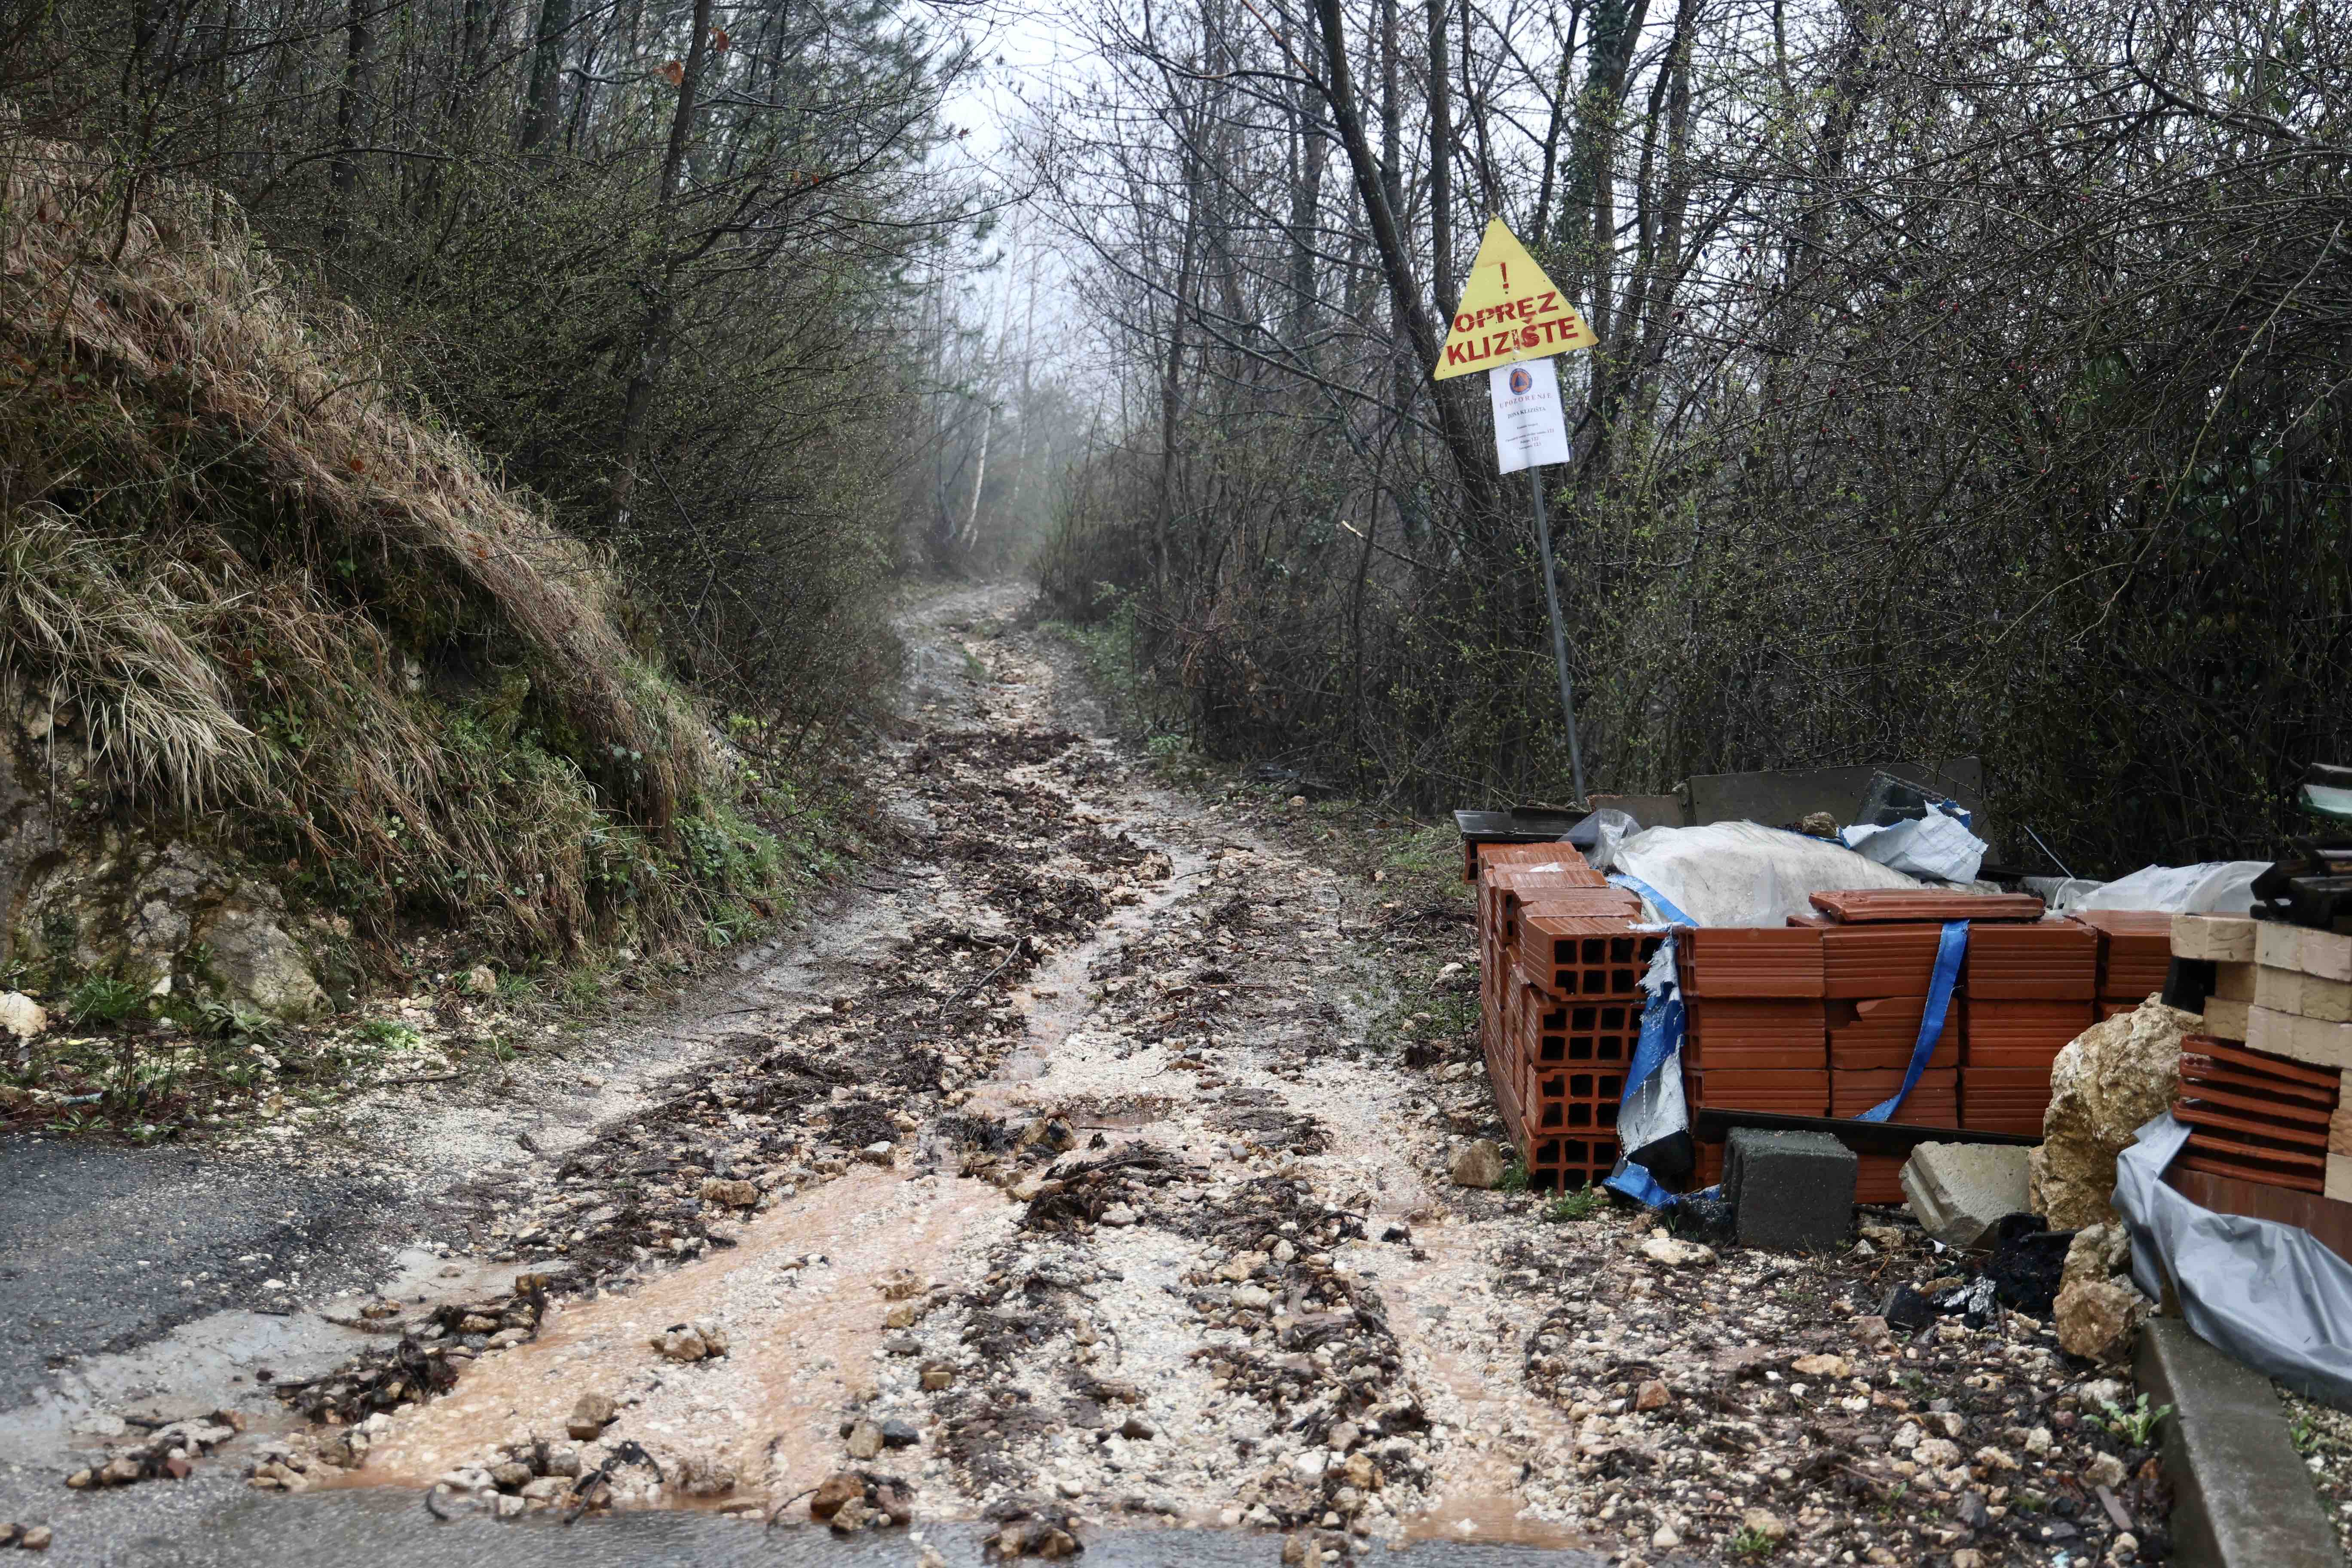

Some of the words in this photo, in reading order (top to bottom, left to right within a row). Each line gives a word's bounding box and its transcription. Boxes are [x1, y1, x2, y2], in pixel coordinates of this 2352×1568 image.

[1500, 262, 1510, 289] !
[1454, 291, 1559, 333] OPREZ
[1446, 316, 1579, 366] KLIZIŠTE
[1499, 392, 1552, 409] UPOZORENJE
